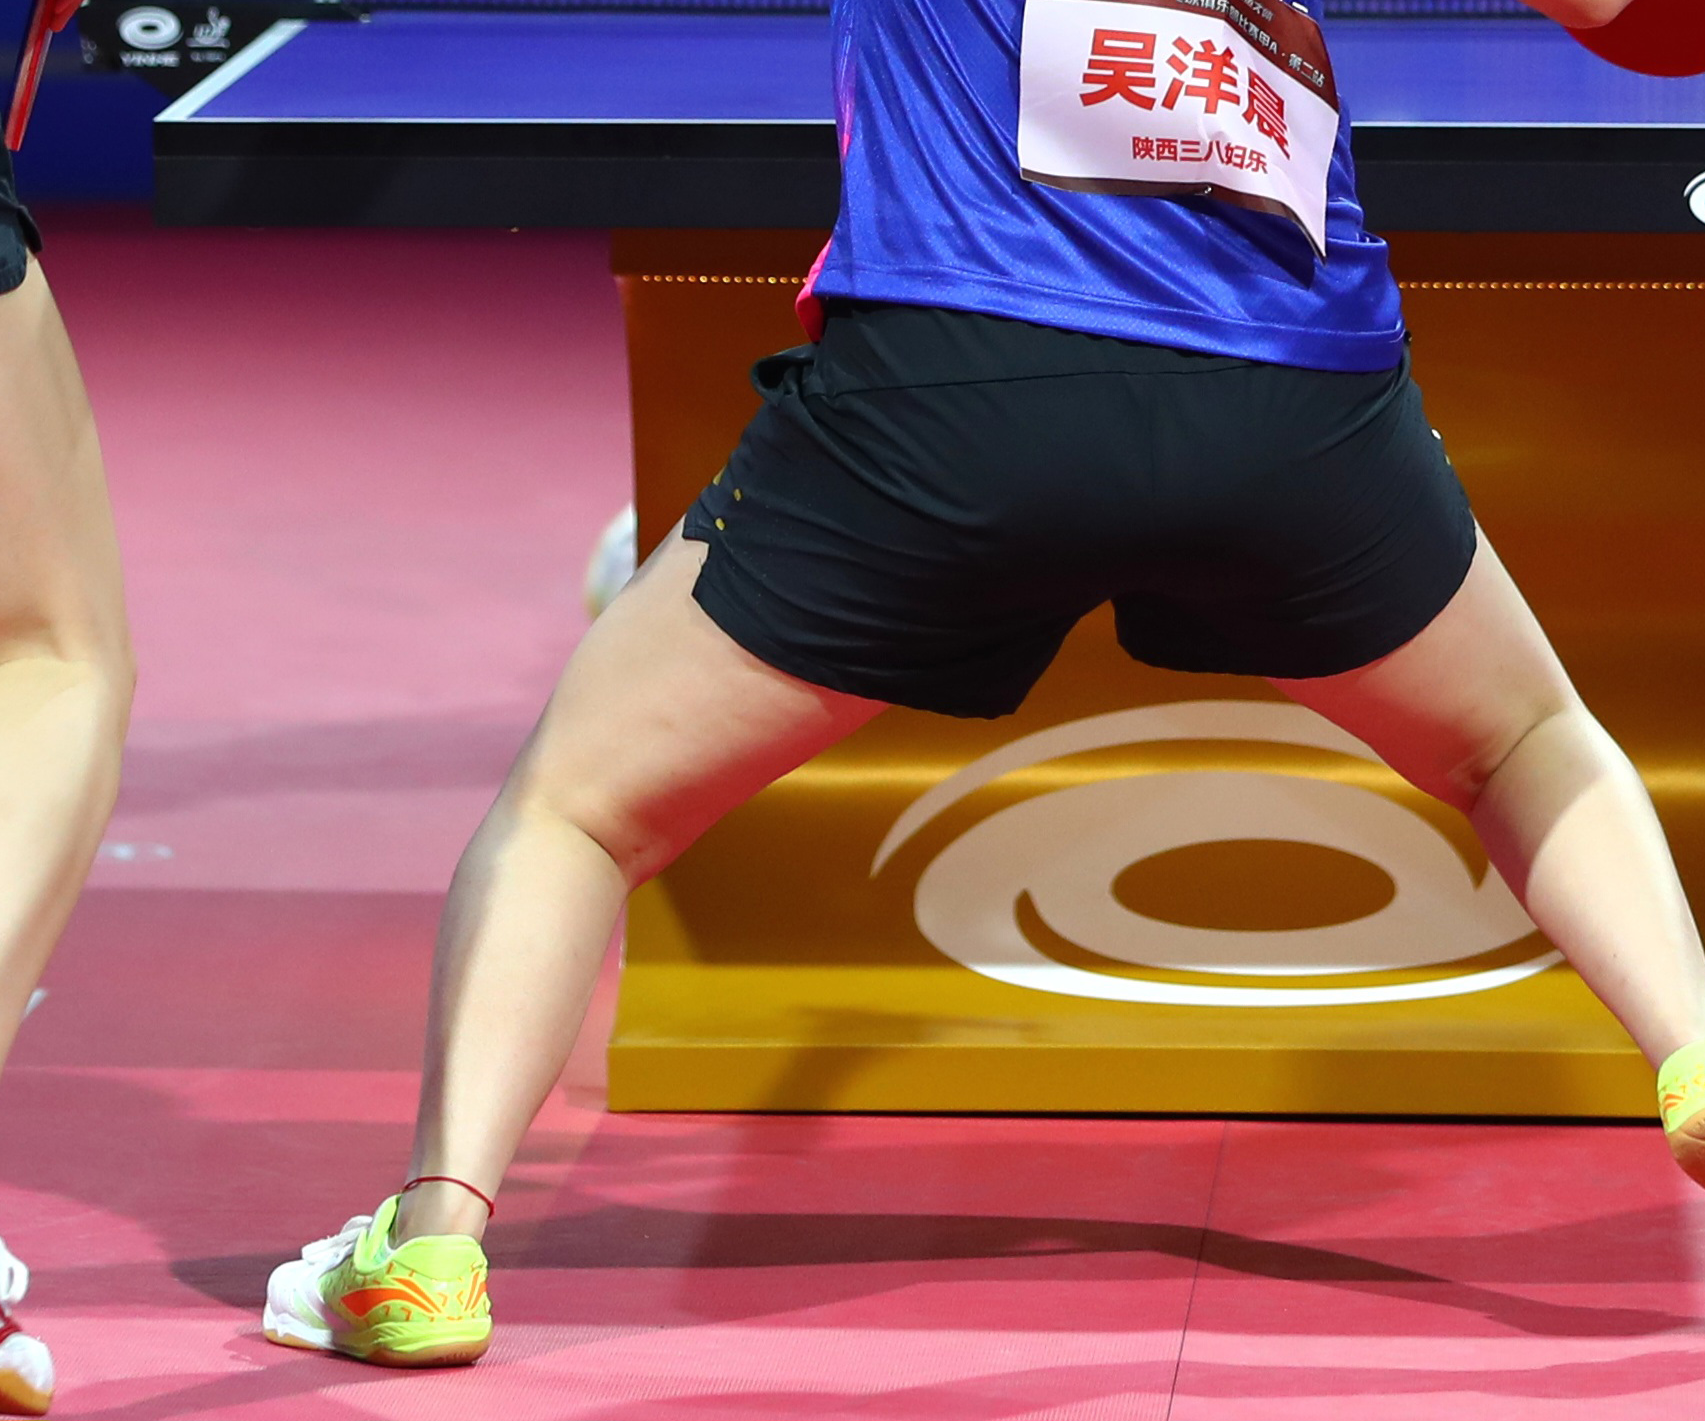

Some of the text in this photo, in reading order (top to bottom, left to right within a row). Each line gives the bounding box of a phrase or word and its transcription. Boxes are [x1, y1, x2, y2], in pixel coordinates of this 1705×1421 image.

[1079, 28, 1291, 161] 吴洋晨
[1131, 136, 1269, 175] 陕西三八妇乐
